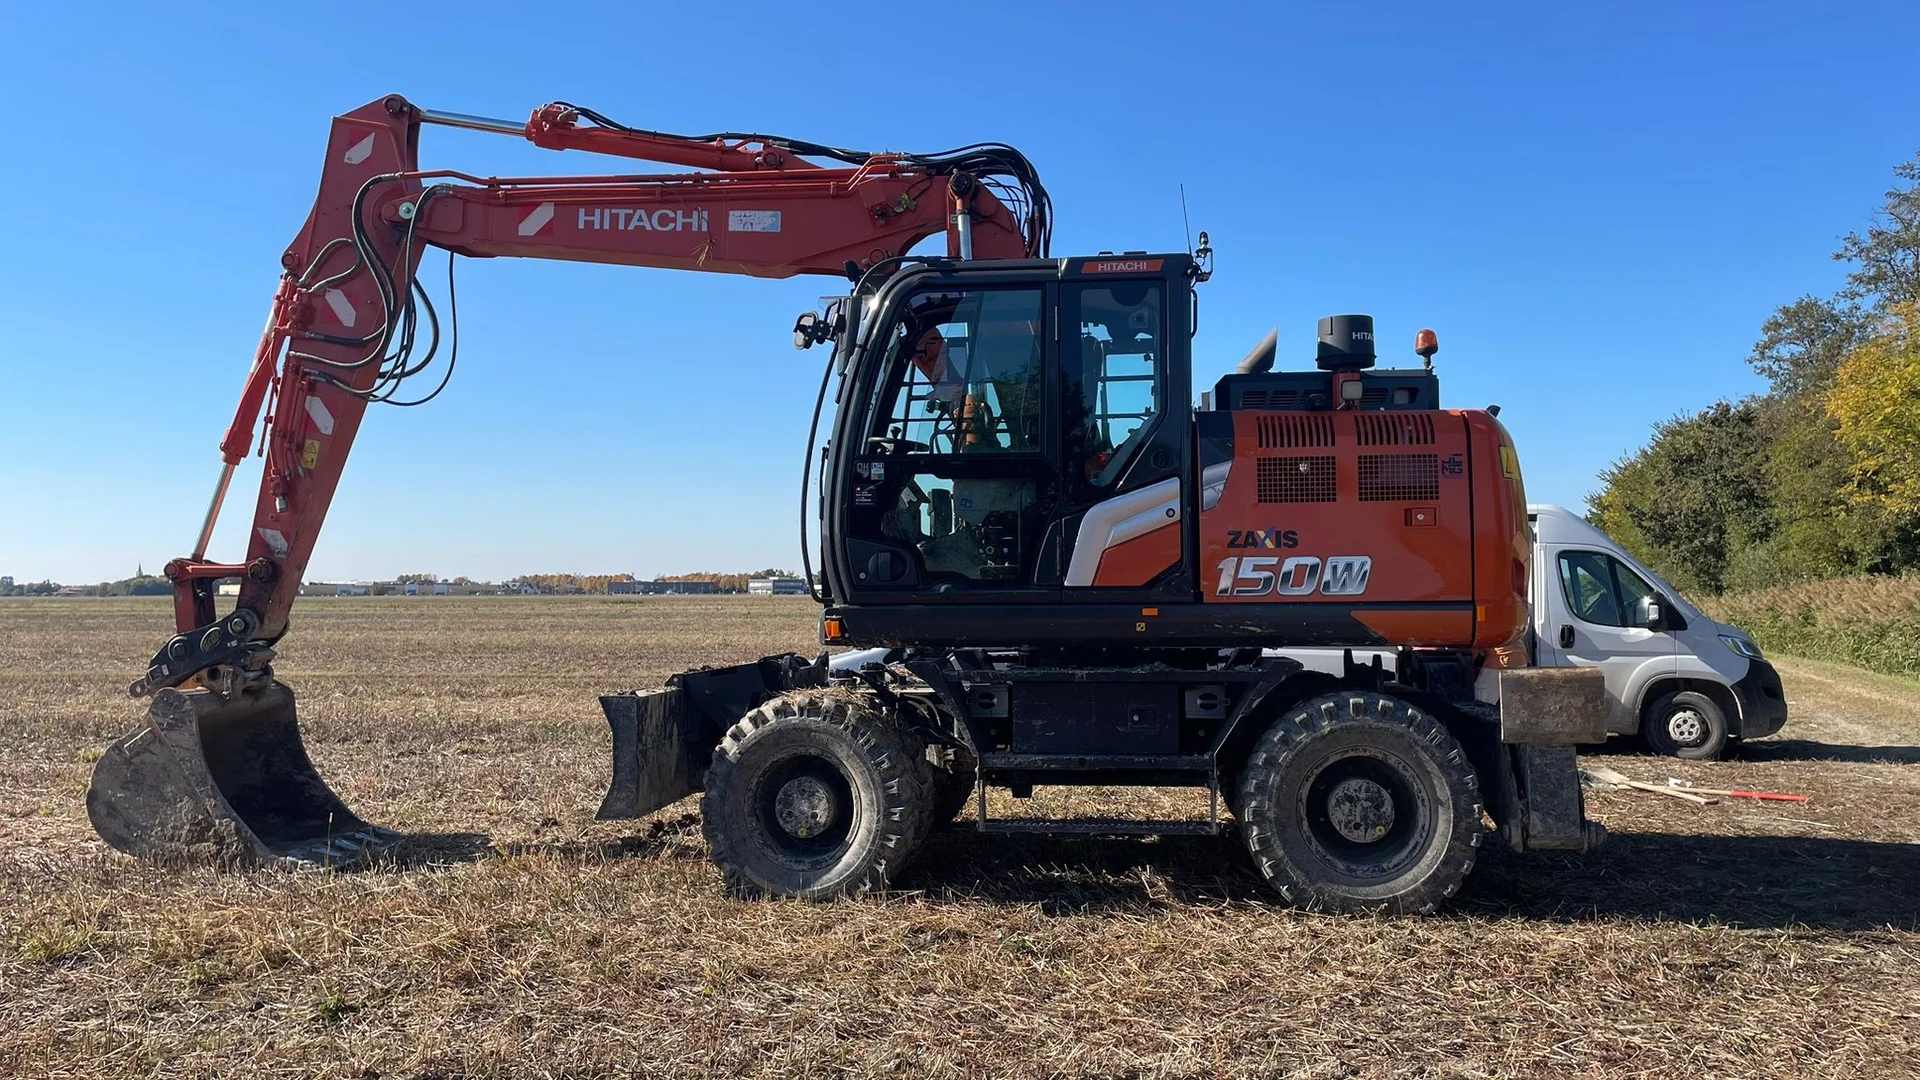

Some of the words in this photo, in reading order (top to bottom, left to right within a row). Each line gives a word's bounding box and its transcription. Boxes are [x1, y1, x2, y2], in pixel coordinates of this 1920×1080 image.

[577, 208, 709, 232] HITACHI
[1098, 261, 1147, 272] HITACHI
[1227, 526, 1299, 549] ZAXIS
[1215, 555, 1373, 597] 150W
